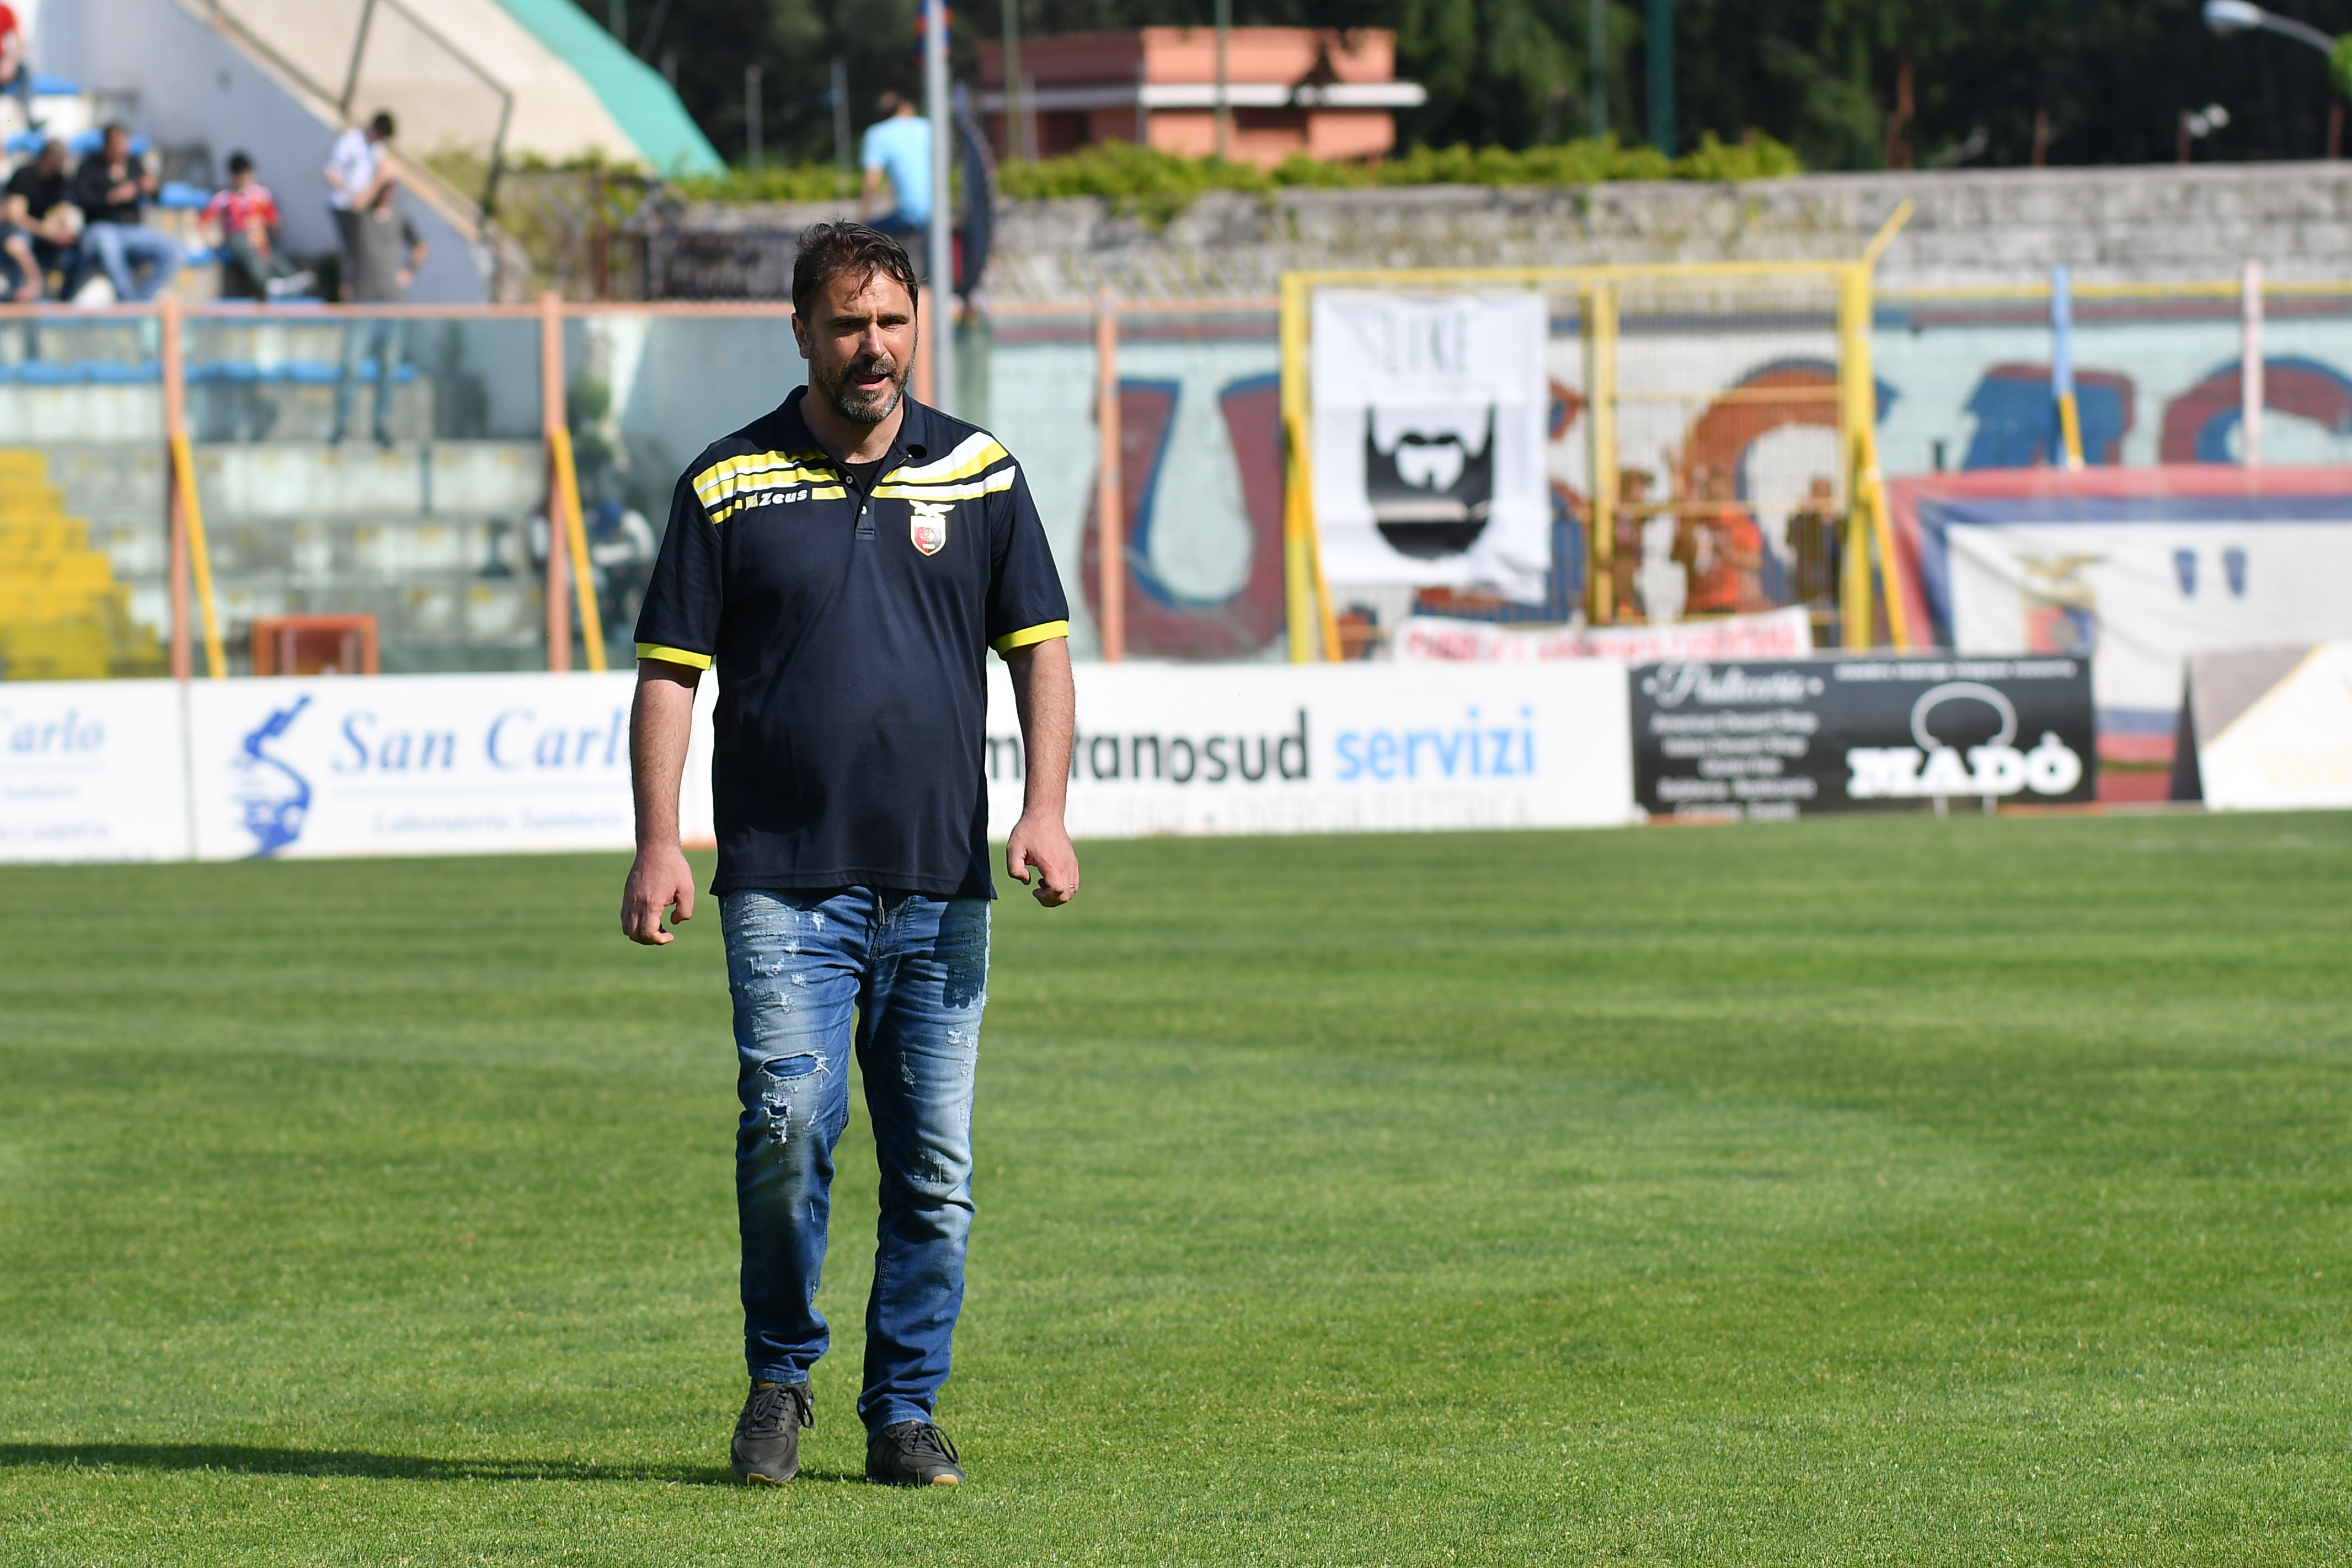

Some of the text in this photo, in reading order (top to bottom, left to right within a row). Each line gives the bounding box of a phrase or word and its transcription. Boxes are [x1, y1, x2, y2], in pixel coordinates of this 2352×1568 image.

[758, 489, 808, 506] Zeus
[0, 709, 105, 754] arlo
[332, 708, 629, 773] San Carl
[1333, 704, 1538, 784] servizi
